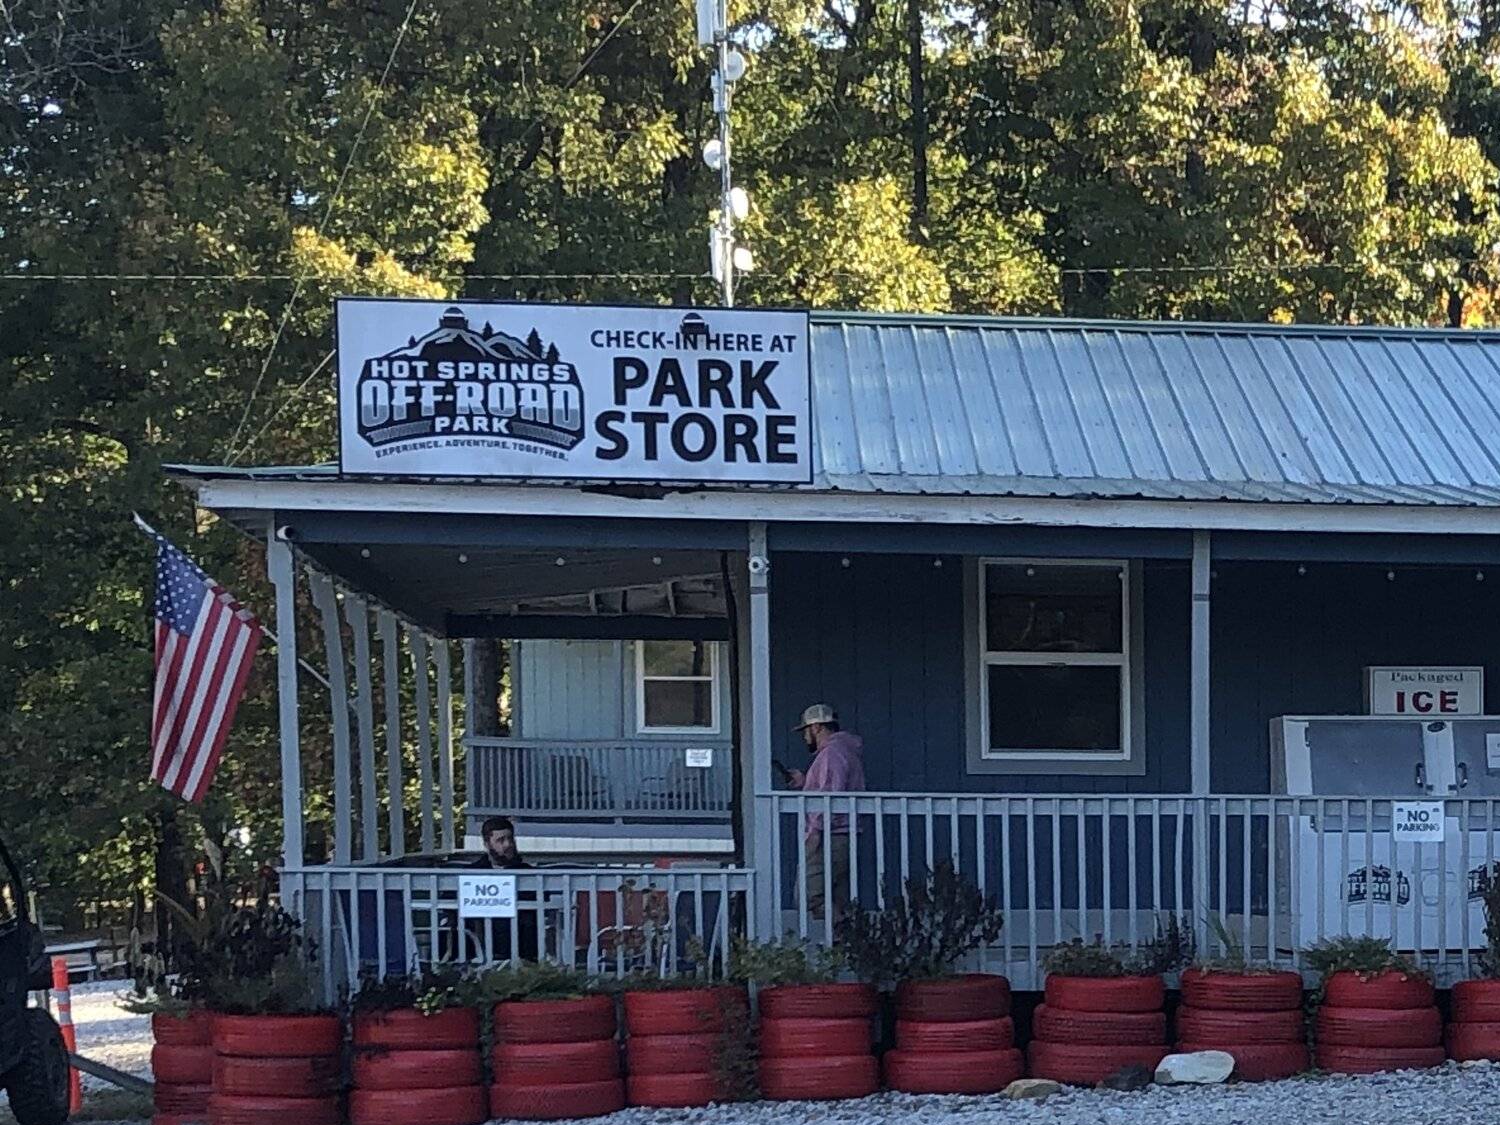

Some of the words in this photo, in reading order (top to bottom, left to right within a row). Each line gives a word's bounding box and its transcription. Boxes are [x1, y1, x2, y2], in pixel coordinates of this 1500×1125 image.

[590, 330, 698, 350] CHECK-IN
[706, 333, 764, 352] HERE
[769, 335, 797, 353] AT
[371, 360, 429, 379] HOT
[437, 361, 571, 382] SPRINGS
[612, 356, 782, 410] PARK
[434, 416, 511, 434] PARK
[594, 410, 799, 465] STORE
[1391, 672, 1464, 684] Packaged
[1396, 690, 1459, 713] ICE
[1407, 810, 1430, 822] NO
[1396, 823, 1440, 832] PARKING
[475, 884, 500, 897] NO
[463, 897, 512, 907] PARKING
